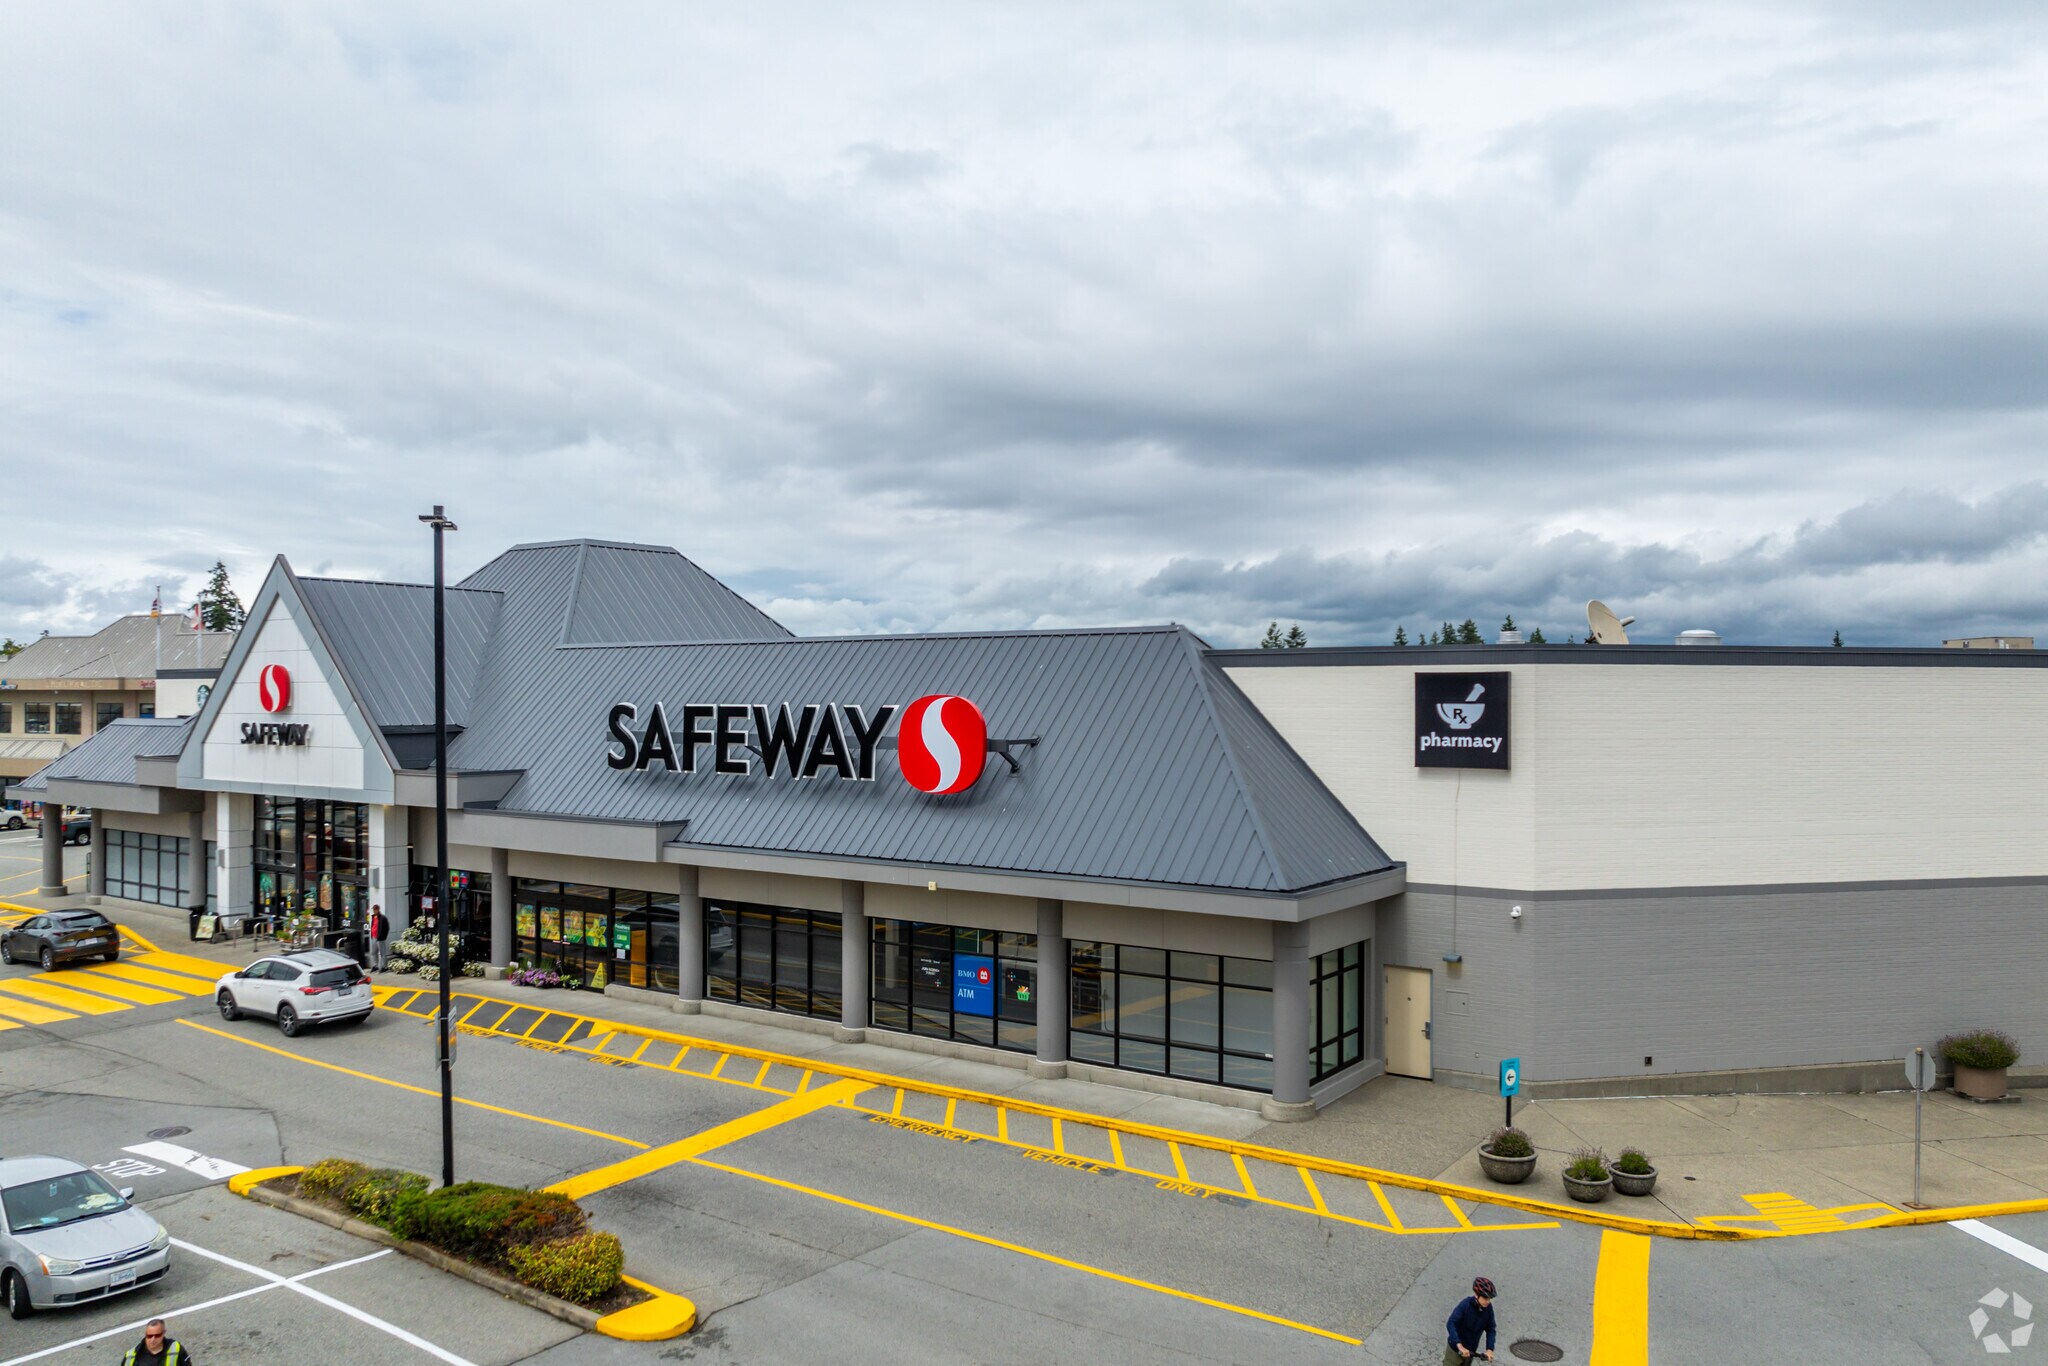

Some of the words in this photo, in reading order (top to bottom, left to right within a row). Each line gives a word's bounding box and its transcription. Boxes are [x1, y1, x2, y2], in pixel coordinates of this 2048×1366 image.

[241, 722, 309, 746] SAFEWAY
[608, 702, 899, 781] SAFEWAY
[1420, 731, 1502, 753] pharmacy
[957, 969, 976, 979] BMO
[957, 988, 975, 999] ATM
[869, 1114, 979, 1143] EMERGENCY
[1022, 1150, 1103, 1173] VEHICLE
[1154, 1179, 1218, 1199] ONLY
[92, 1158, 166, 1178] STOP
